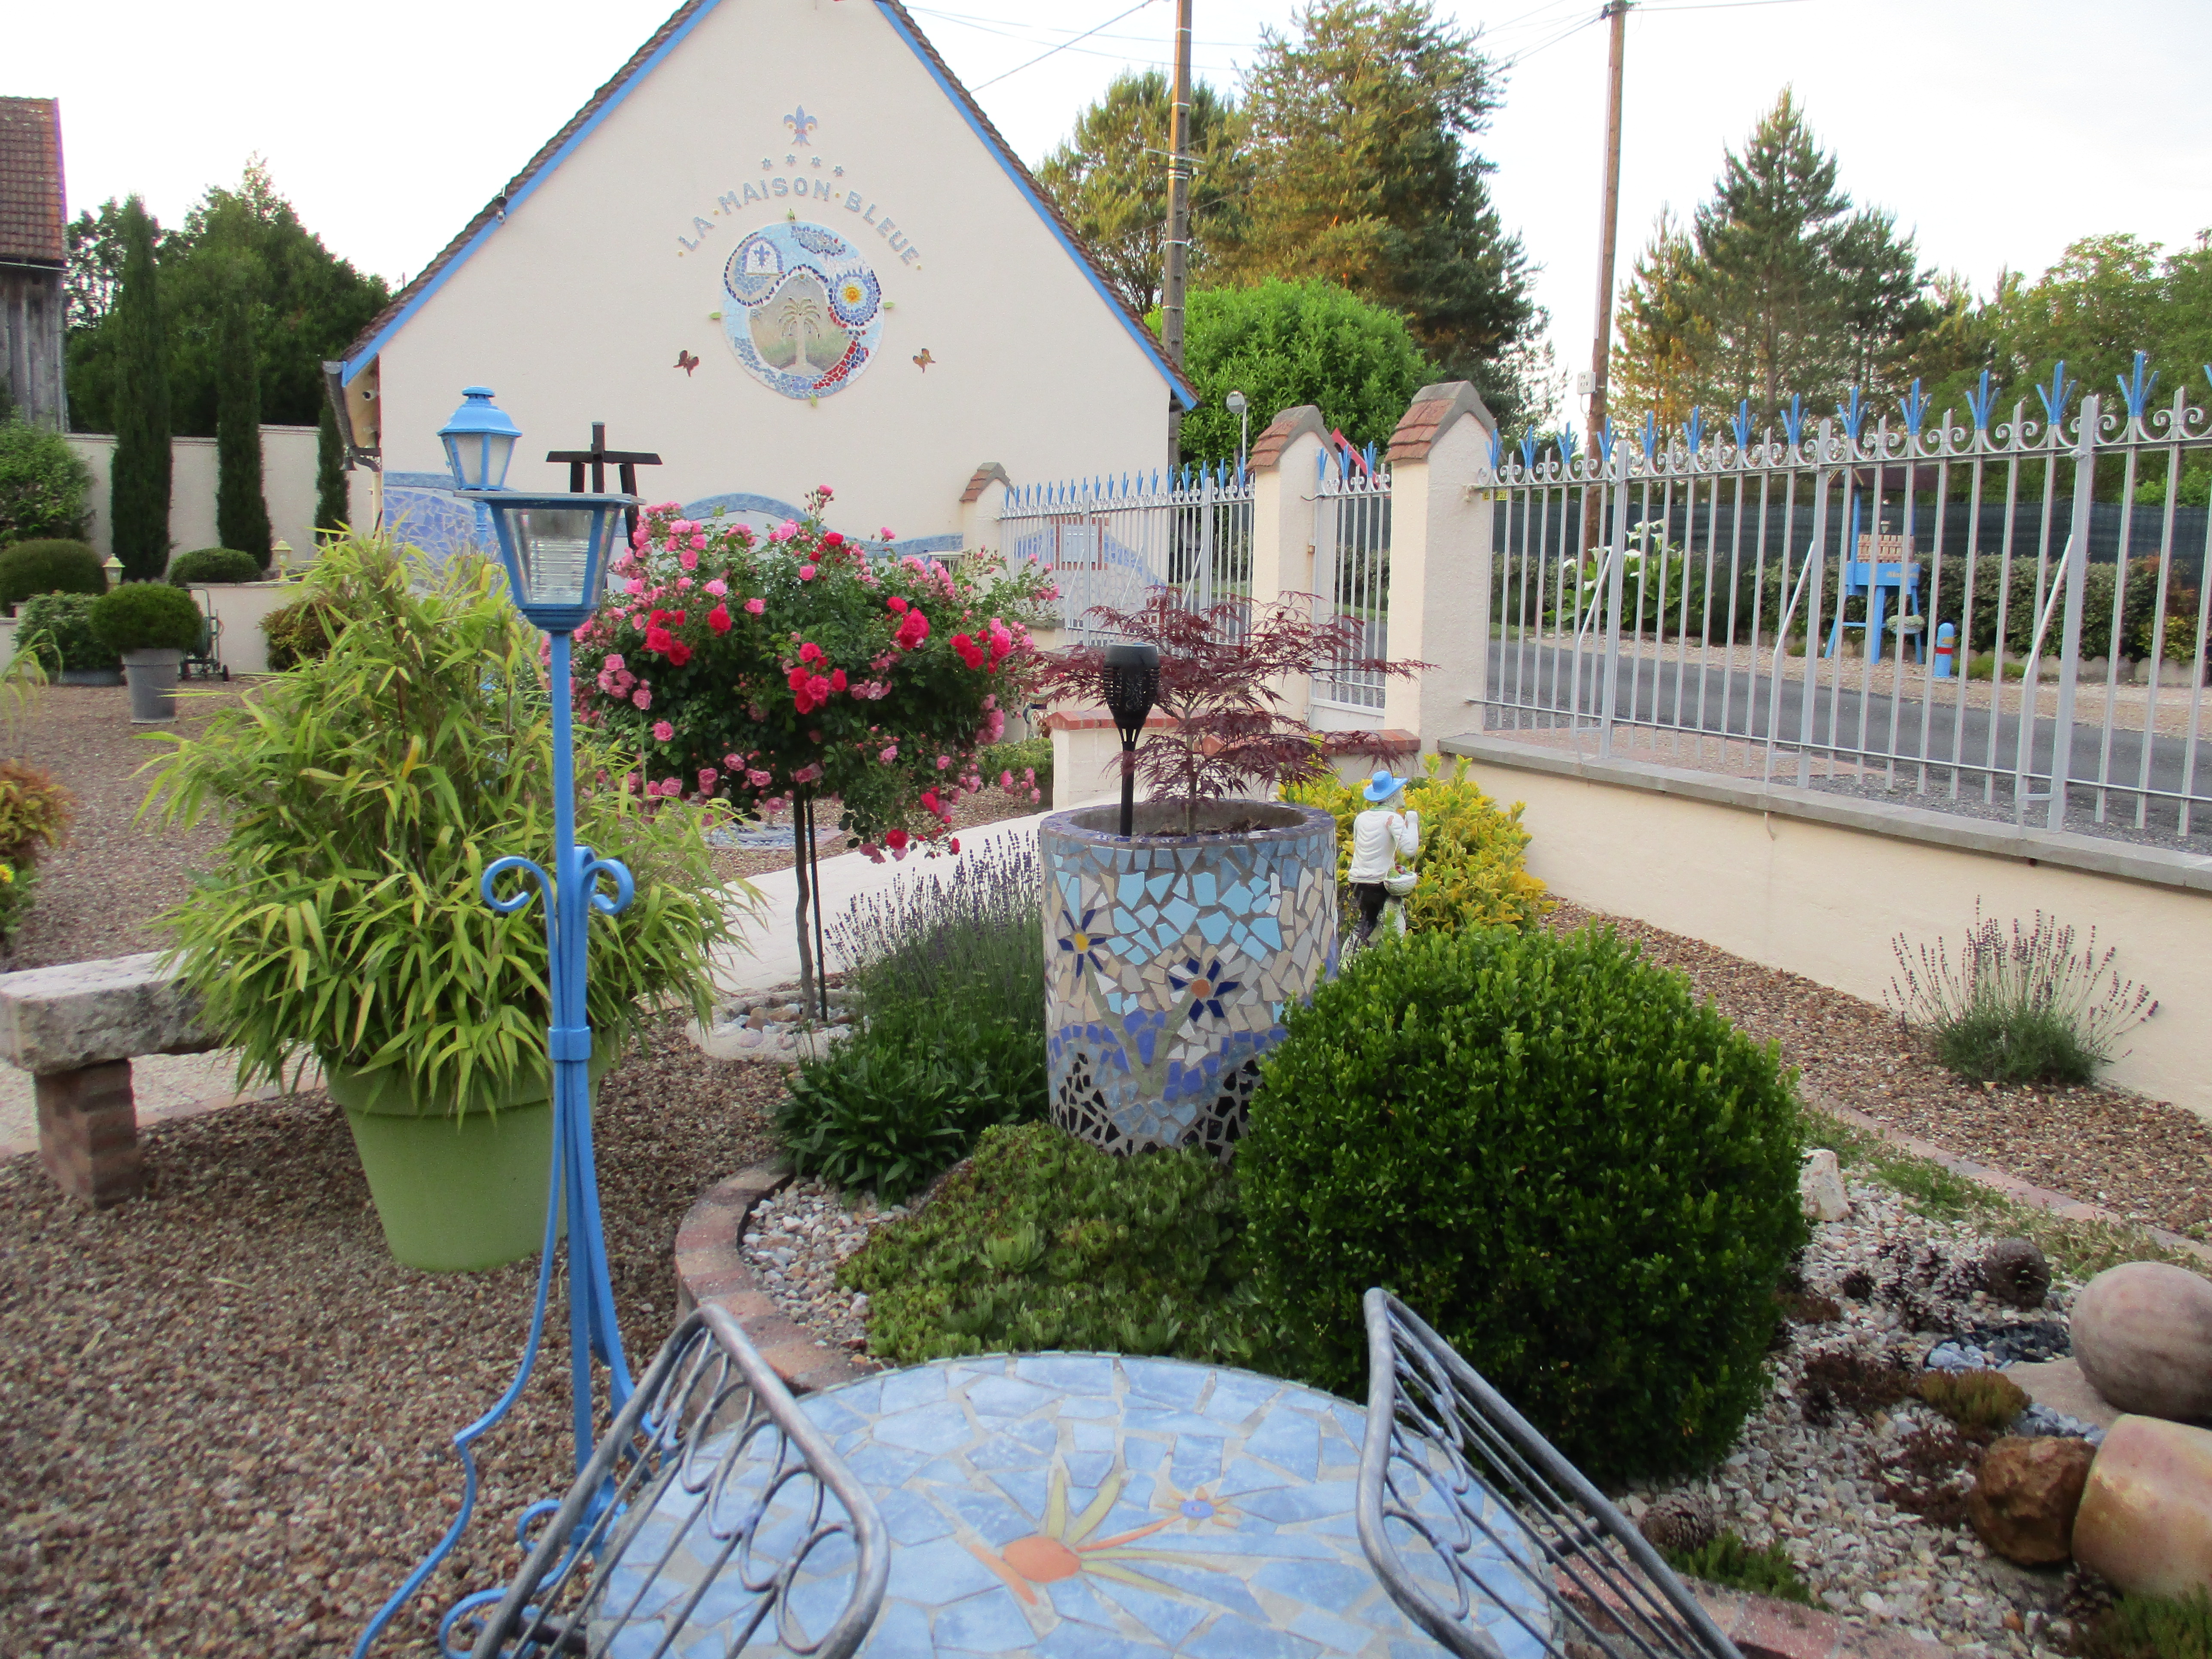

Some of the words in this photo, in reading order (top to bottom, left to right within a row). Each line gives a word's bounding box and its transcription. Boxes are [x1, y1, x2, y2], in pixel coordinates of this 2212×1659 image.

[678, 216, 715, 252] LA
[718, 177, 830, 215] MAISON
[845, 191, 919, 265] BLEUE
